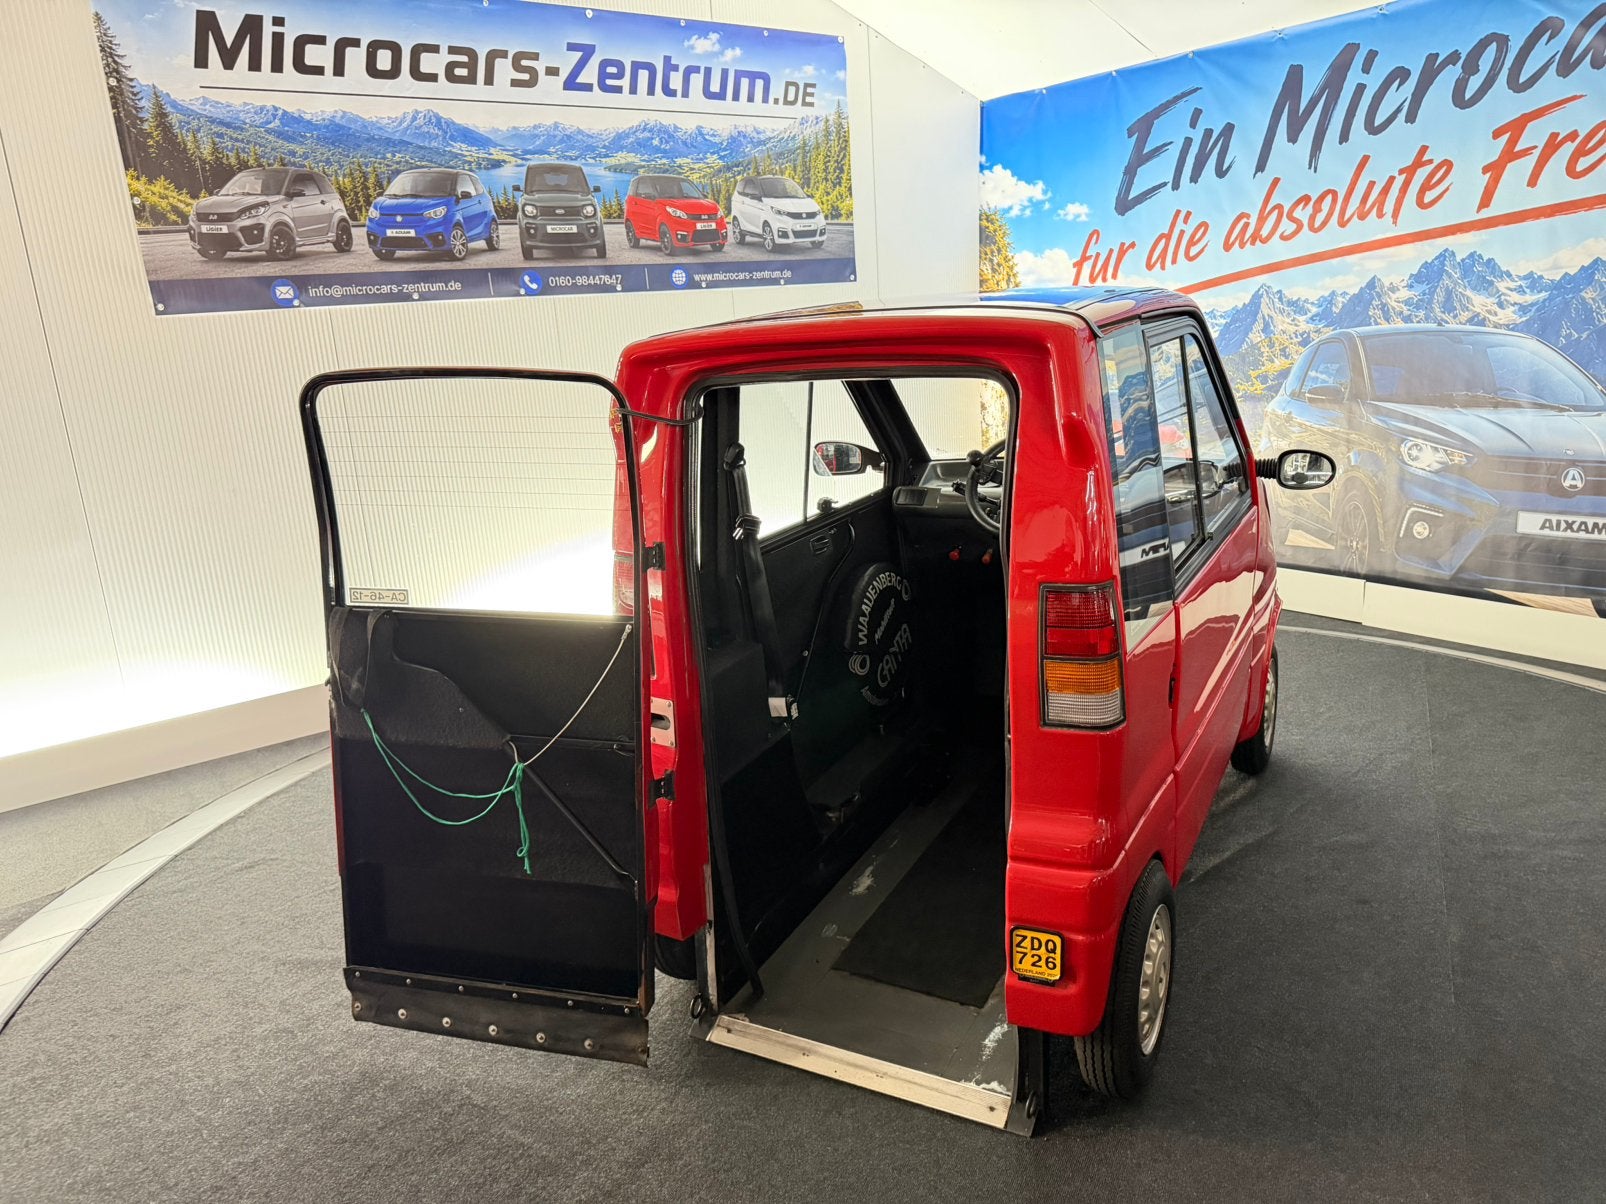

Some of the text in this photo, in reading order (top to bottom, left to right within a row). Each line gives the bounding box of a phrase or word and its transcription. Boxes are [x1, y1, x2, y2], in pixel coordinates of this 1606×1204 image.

[1113, 85, 1237, 217] Ein
[1072, 229, 1137, 286] fur
[1145, 208, 1210, 272] die
[1222, 144, 1455, 248] absolute
[548, 274, 622, 287] 0160-98447647
[693, 269, 792, 282] www.microcars-zentrum.de
[308, 280, 462, 297] info@microcars-zentrum.de
[1015, 933, 1057, 955] ZDQ
[1015, 950, 1057, 971] 726
